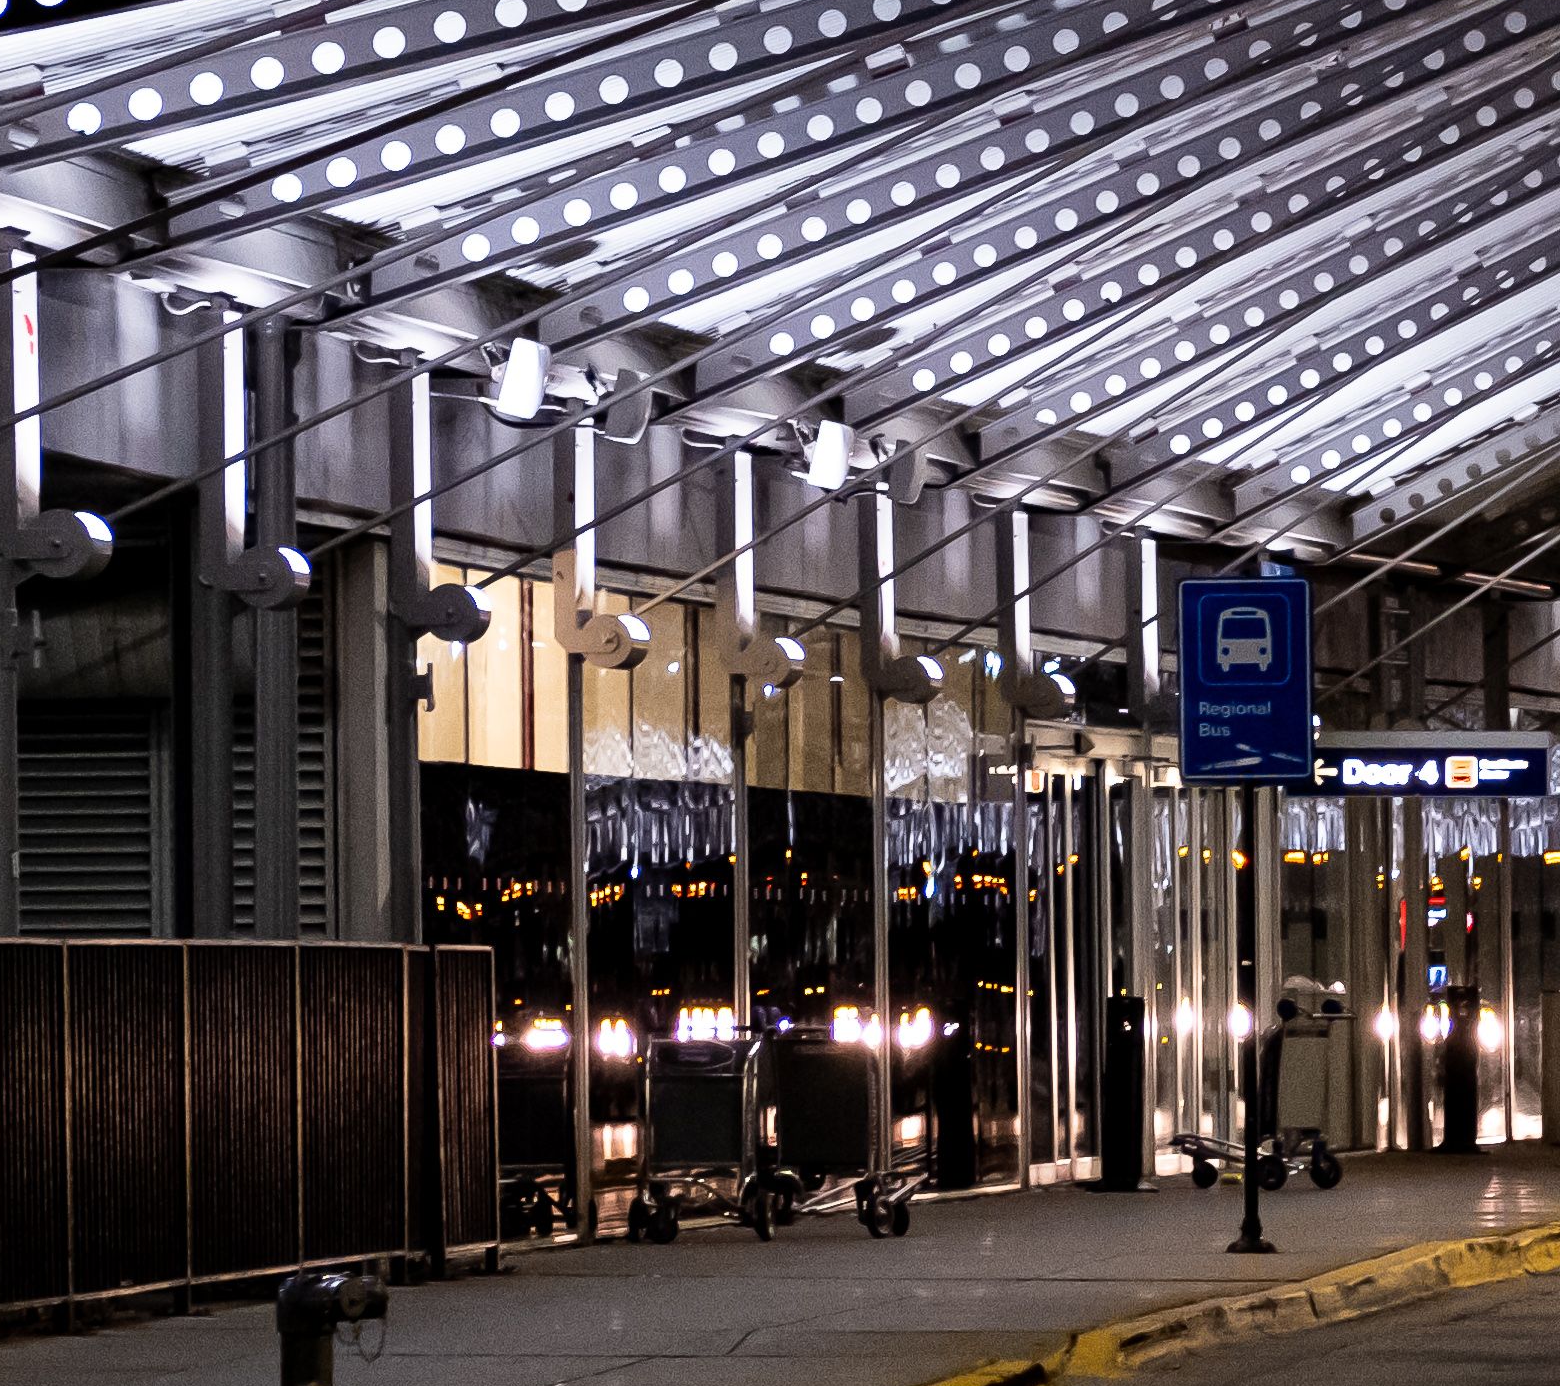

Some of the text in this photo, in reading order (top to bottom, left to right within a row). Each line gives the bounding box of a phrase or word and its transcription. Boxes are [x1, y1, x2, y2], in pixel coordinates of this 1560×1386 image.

[1199, 701, 1271, 717] Regional
[1199, 723, 1231, 737] Bus
[1342, 758, 1440, 785] Door 4
